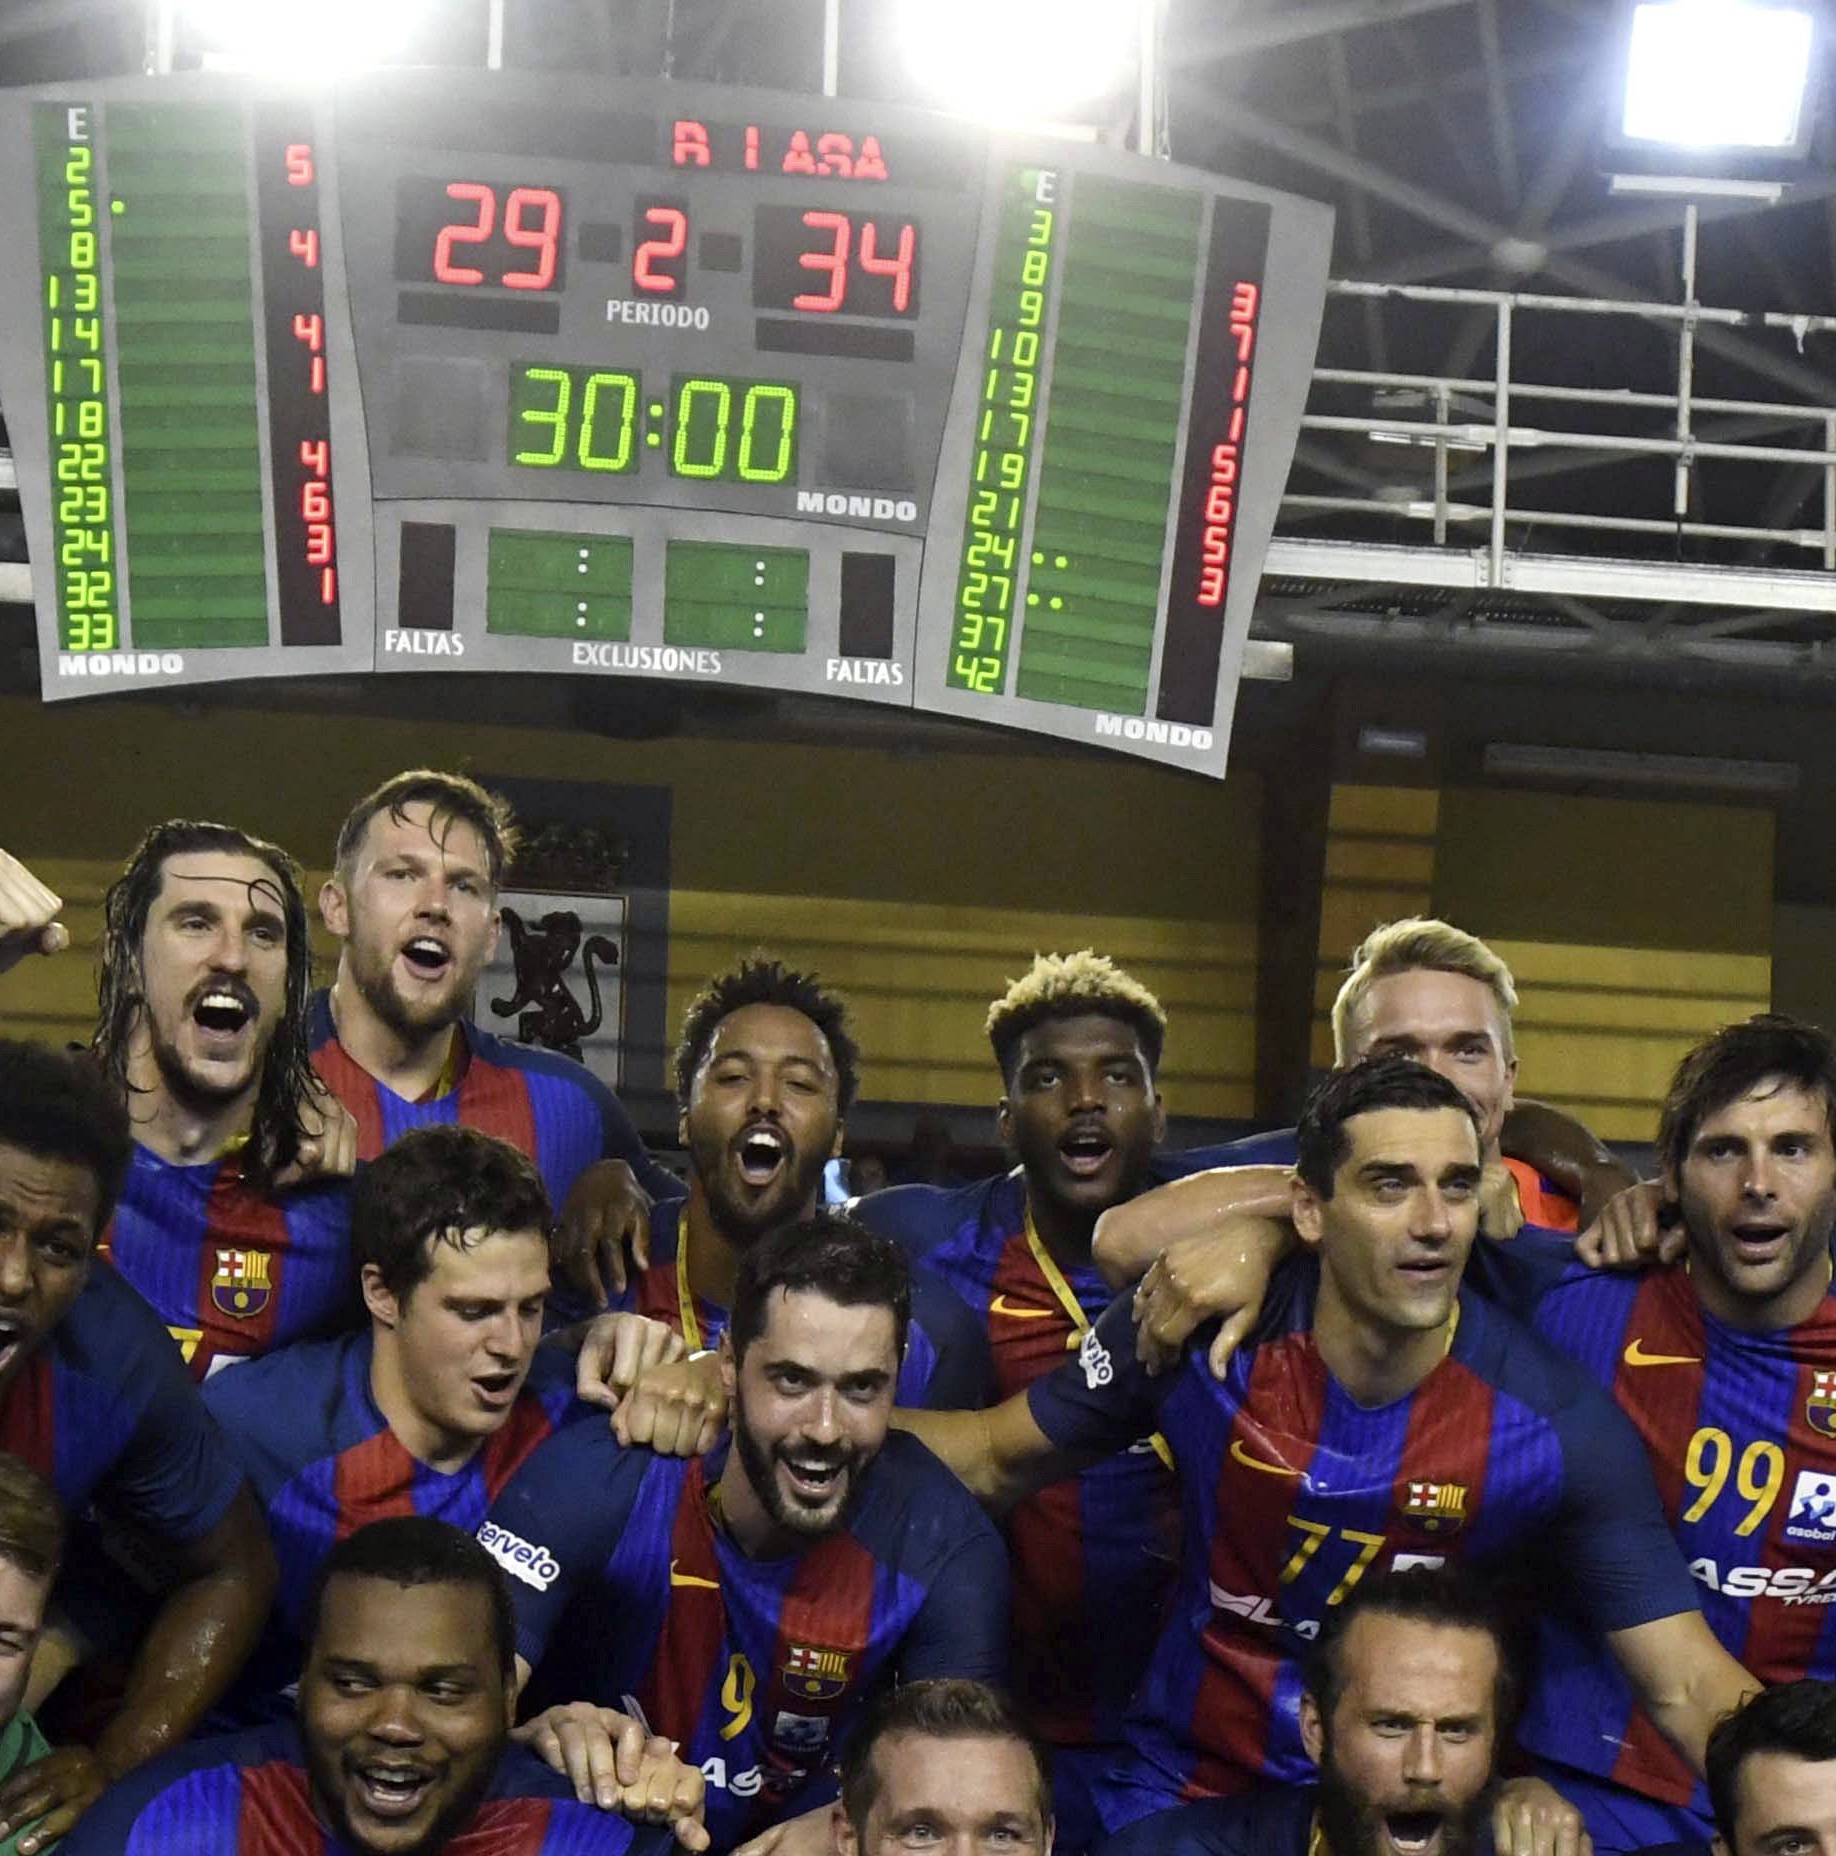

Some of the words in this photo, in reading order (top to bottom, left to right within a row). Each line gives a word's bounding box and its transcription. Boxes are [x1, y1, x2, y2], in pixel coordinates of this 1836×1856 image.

[68, 108, 87, 139] E
[66, 147, 91, 184] 2
[285, 144, 313, 185] 5
[68, 189, 92, 226] 5
[433, 182, 561, 290] 29
[1028, 210, 1053, 245] 3
[71, 231, 96, 268] 8
[289, 229, 318, 268] 4
[634, 208, 687, 291] 2
[793, 211, 916, 313] 34
[1022, 250, 1047, 286] 8
[50, 274, 97, 310] 13
[1019, 290, 1044, 325] 9
[1229, 282, 1258, 322] 3
[294, 314, 322, 352] 4
[607, 300, 711, 331] PERIODO
[51, 318, 99, 352] 14
[990, 328, 1039, 367] 10
[1230, 324, 1254, 361] 7
[53, 359, 102, 394] 17
[311, 356, 324, 394] 1
[986, 368, 1034, 407] 13
[1232, 366, 1249, 401] 1
[56, 401, 103, 437] 18
[515, 368, 795, 482] 30:00
[981, 410, 1029, 447] 17
[1228, 407, 1244, 442] 1
[58, 443, 105, 480] 22
[301, 441, 328, 478] 4
[976, 450, 1025, 489] 19
[1212, 444, 1238, 483] 5
[60, 486, 107, 523] 23
[302, 481, 330, 522] 6
[797, 491, 917, 522] MONDO
[971, 491, 1019, 528] 21
[1205, 486, 1232, 524] 6
[62, 529, 109, 566] 24
[306, 524, 333, 563] 3
[967, 531, 1014, 569] 24
[1203, 526, 1228, 565] 5
[66, 572, 111, 608] 32
[321, 567, 335, 605] 1
[962, 572, 1010, 610] 27
[1197, 567, 1225, 606] 3
[68, 614, 115, 651] 33
[385, 629, 464, 656] FALTAS
[959, 613, 1005, 651] 37
[58, 654, 184, 677] MONDO
[572, 642, 722, 674] EXCLUSIONES
[826, 658, 903, 686] FALTAS
[955, 655, 1001, 693] 42
[1095, 713, 1214, 750] MONDO
[1683, 1427, 1785, 1537] 99
[1786, 1525, 1836, 1542] asobal
[479, 1526, 557, 1580] erveto
[1279, 1514, 1388, 1606] 77
[720, 1653, 756, 1741] 9
